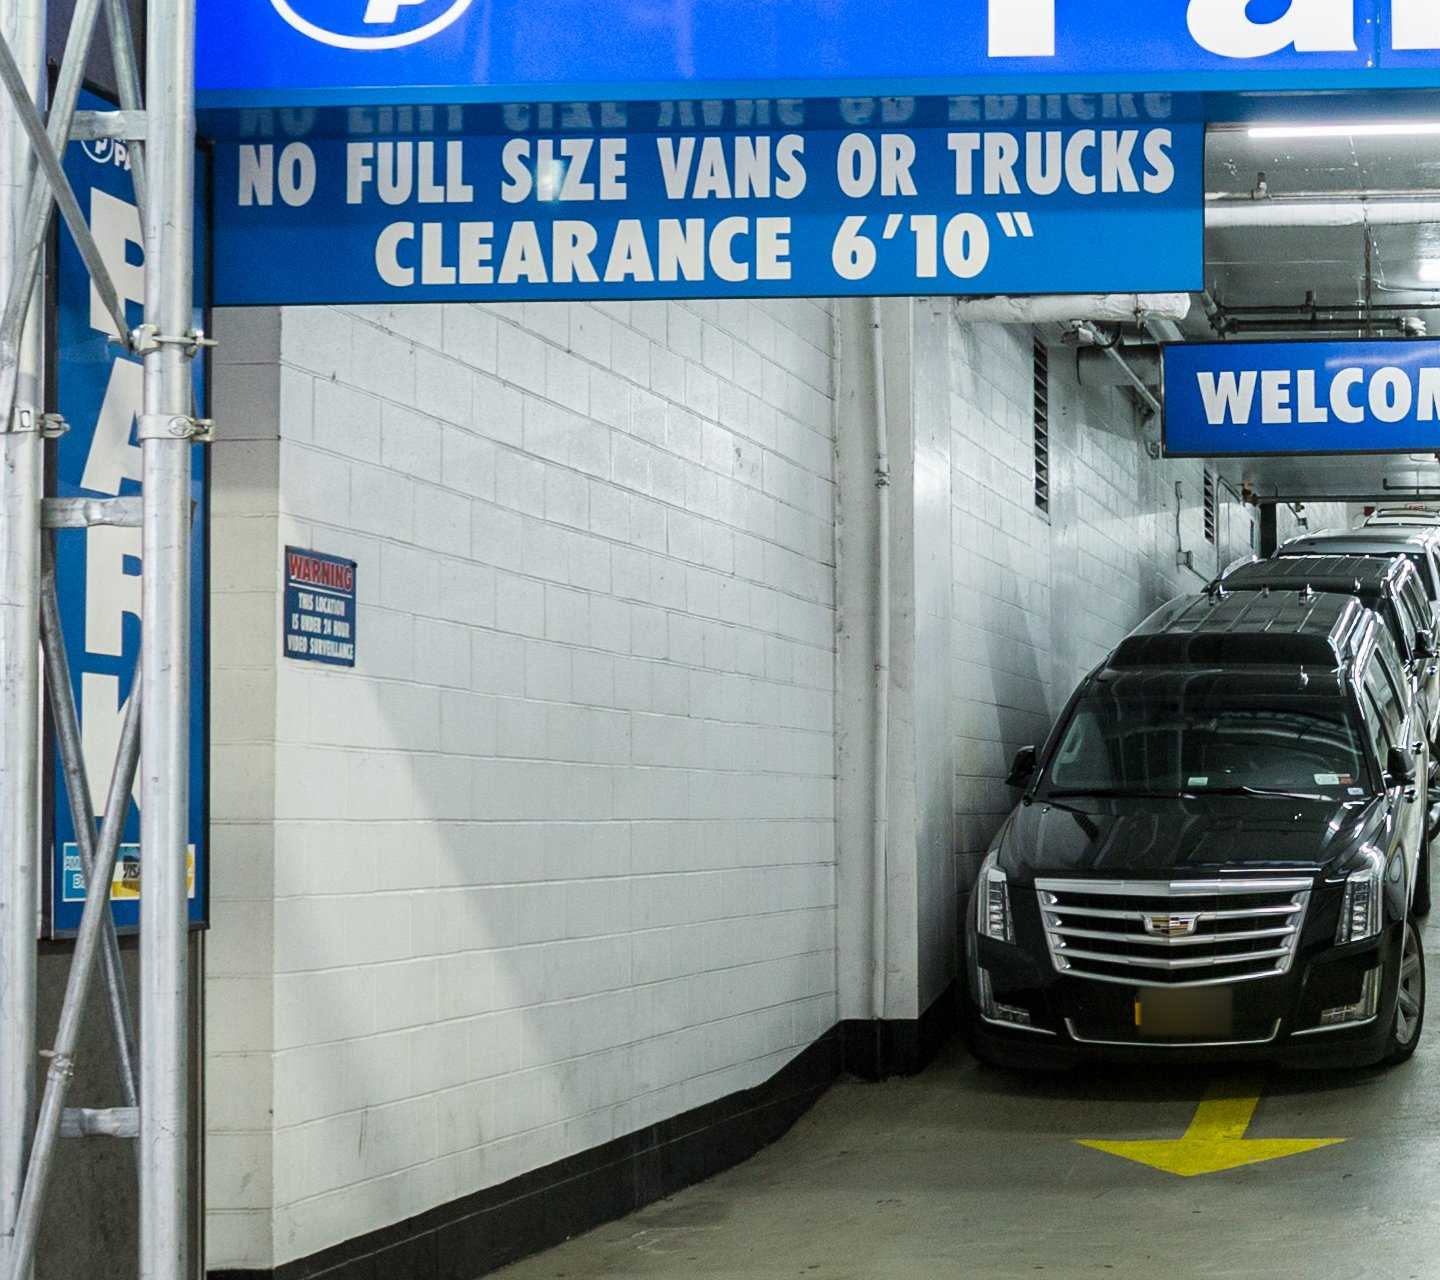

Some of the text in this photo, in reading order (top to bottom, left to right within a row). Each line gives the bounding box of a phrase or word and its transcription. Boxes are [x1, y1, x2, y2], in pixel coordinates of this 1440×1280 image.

[239, 128, 1175, 207] NO FULL SIZE VANS OR TRUCKS
[375, 218, 791, 288] CLEARANCE
[288, 553, 353, 591] WARNING
[298, 592, 345, 616] THIS LOCATION
[301, 614, 321, 633] UNDER
[288, 635, 353, 659] VIDEO SURVEILLANCE
